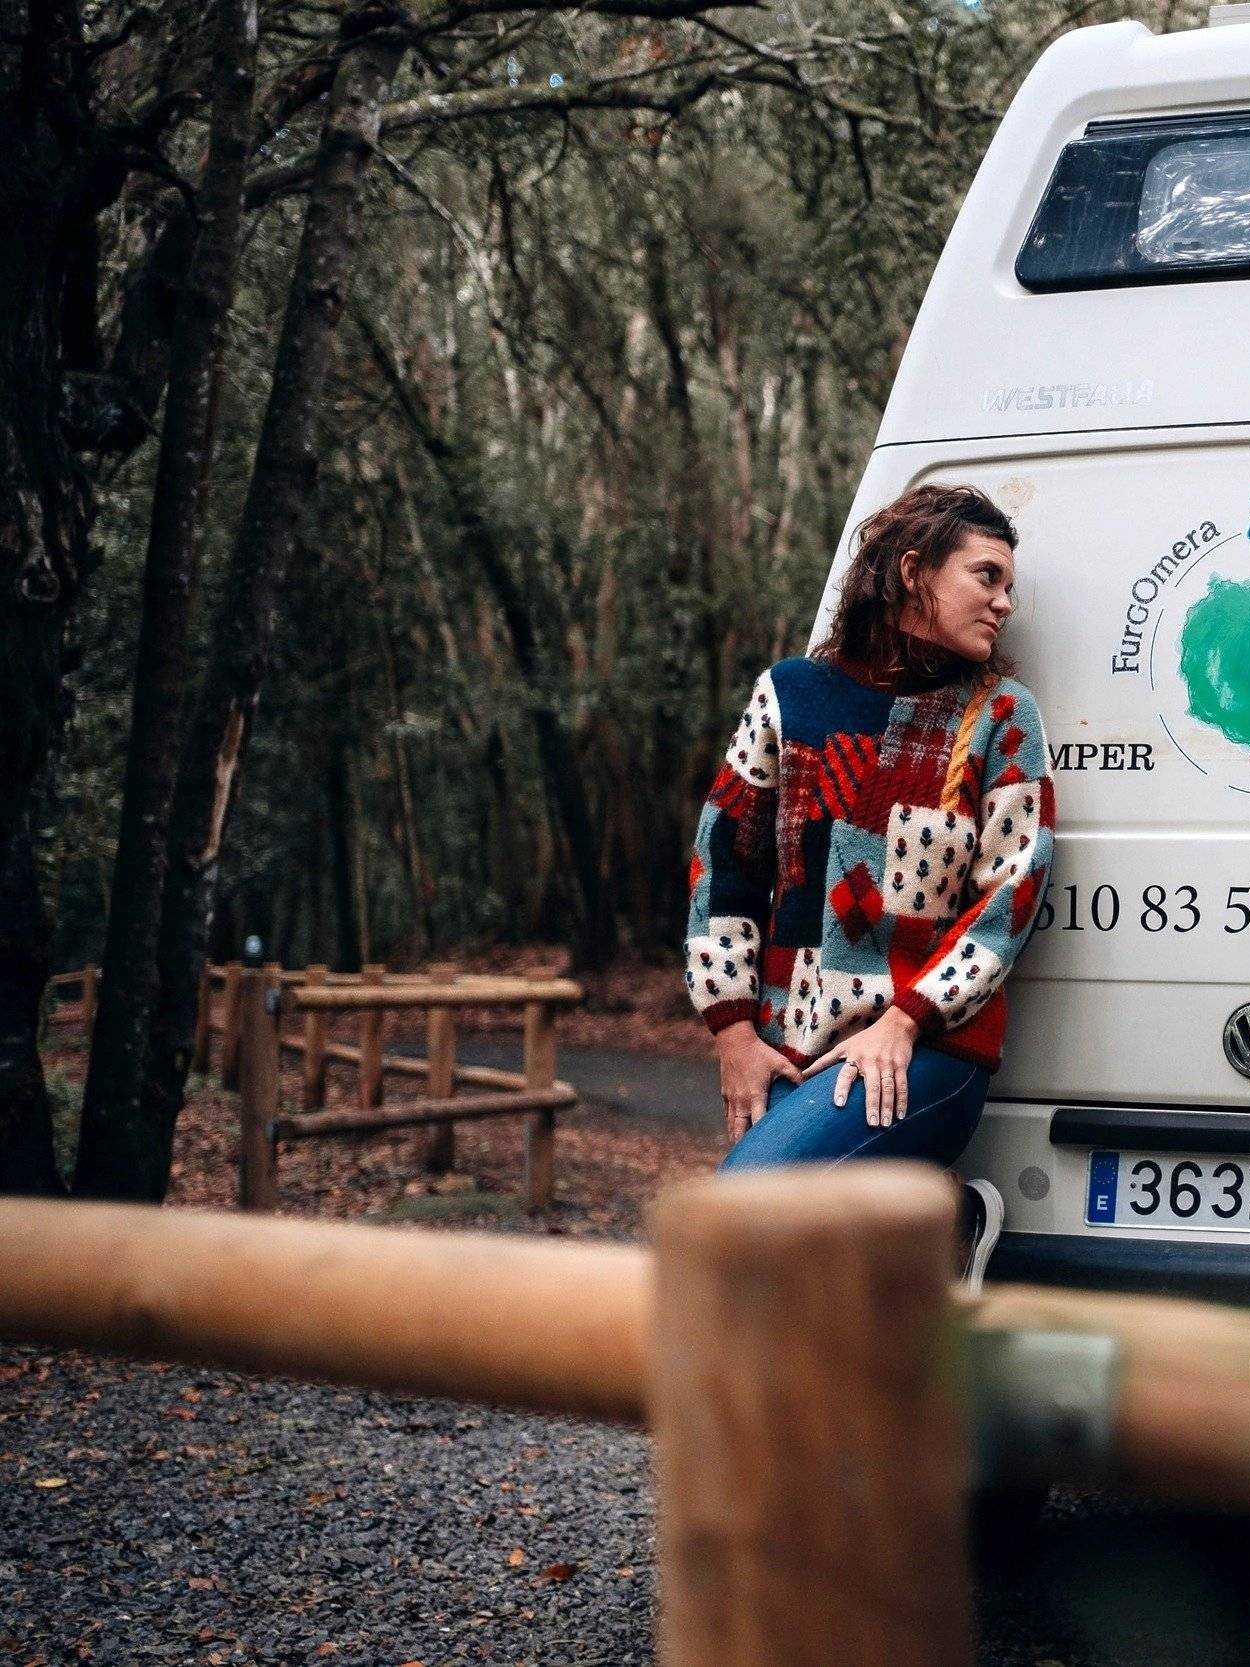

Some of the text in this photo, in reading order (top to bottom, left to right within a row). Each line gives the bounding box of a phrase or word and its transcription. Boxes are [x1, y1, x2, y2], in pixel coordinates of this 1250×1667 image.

[981, 378, 1153, 412] WESTFALIA
[1140, 885, 1200, 933] 83
[1096, 1195, 1108, 1211] E
